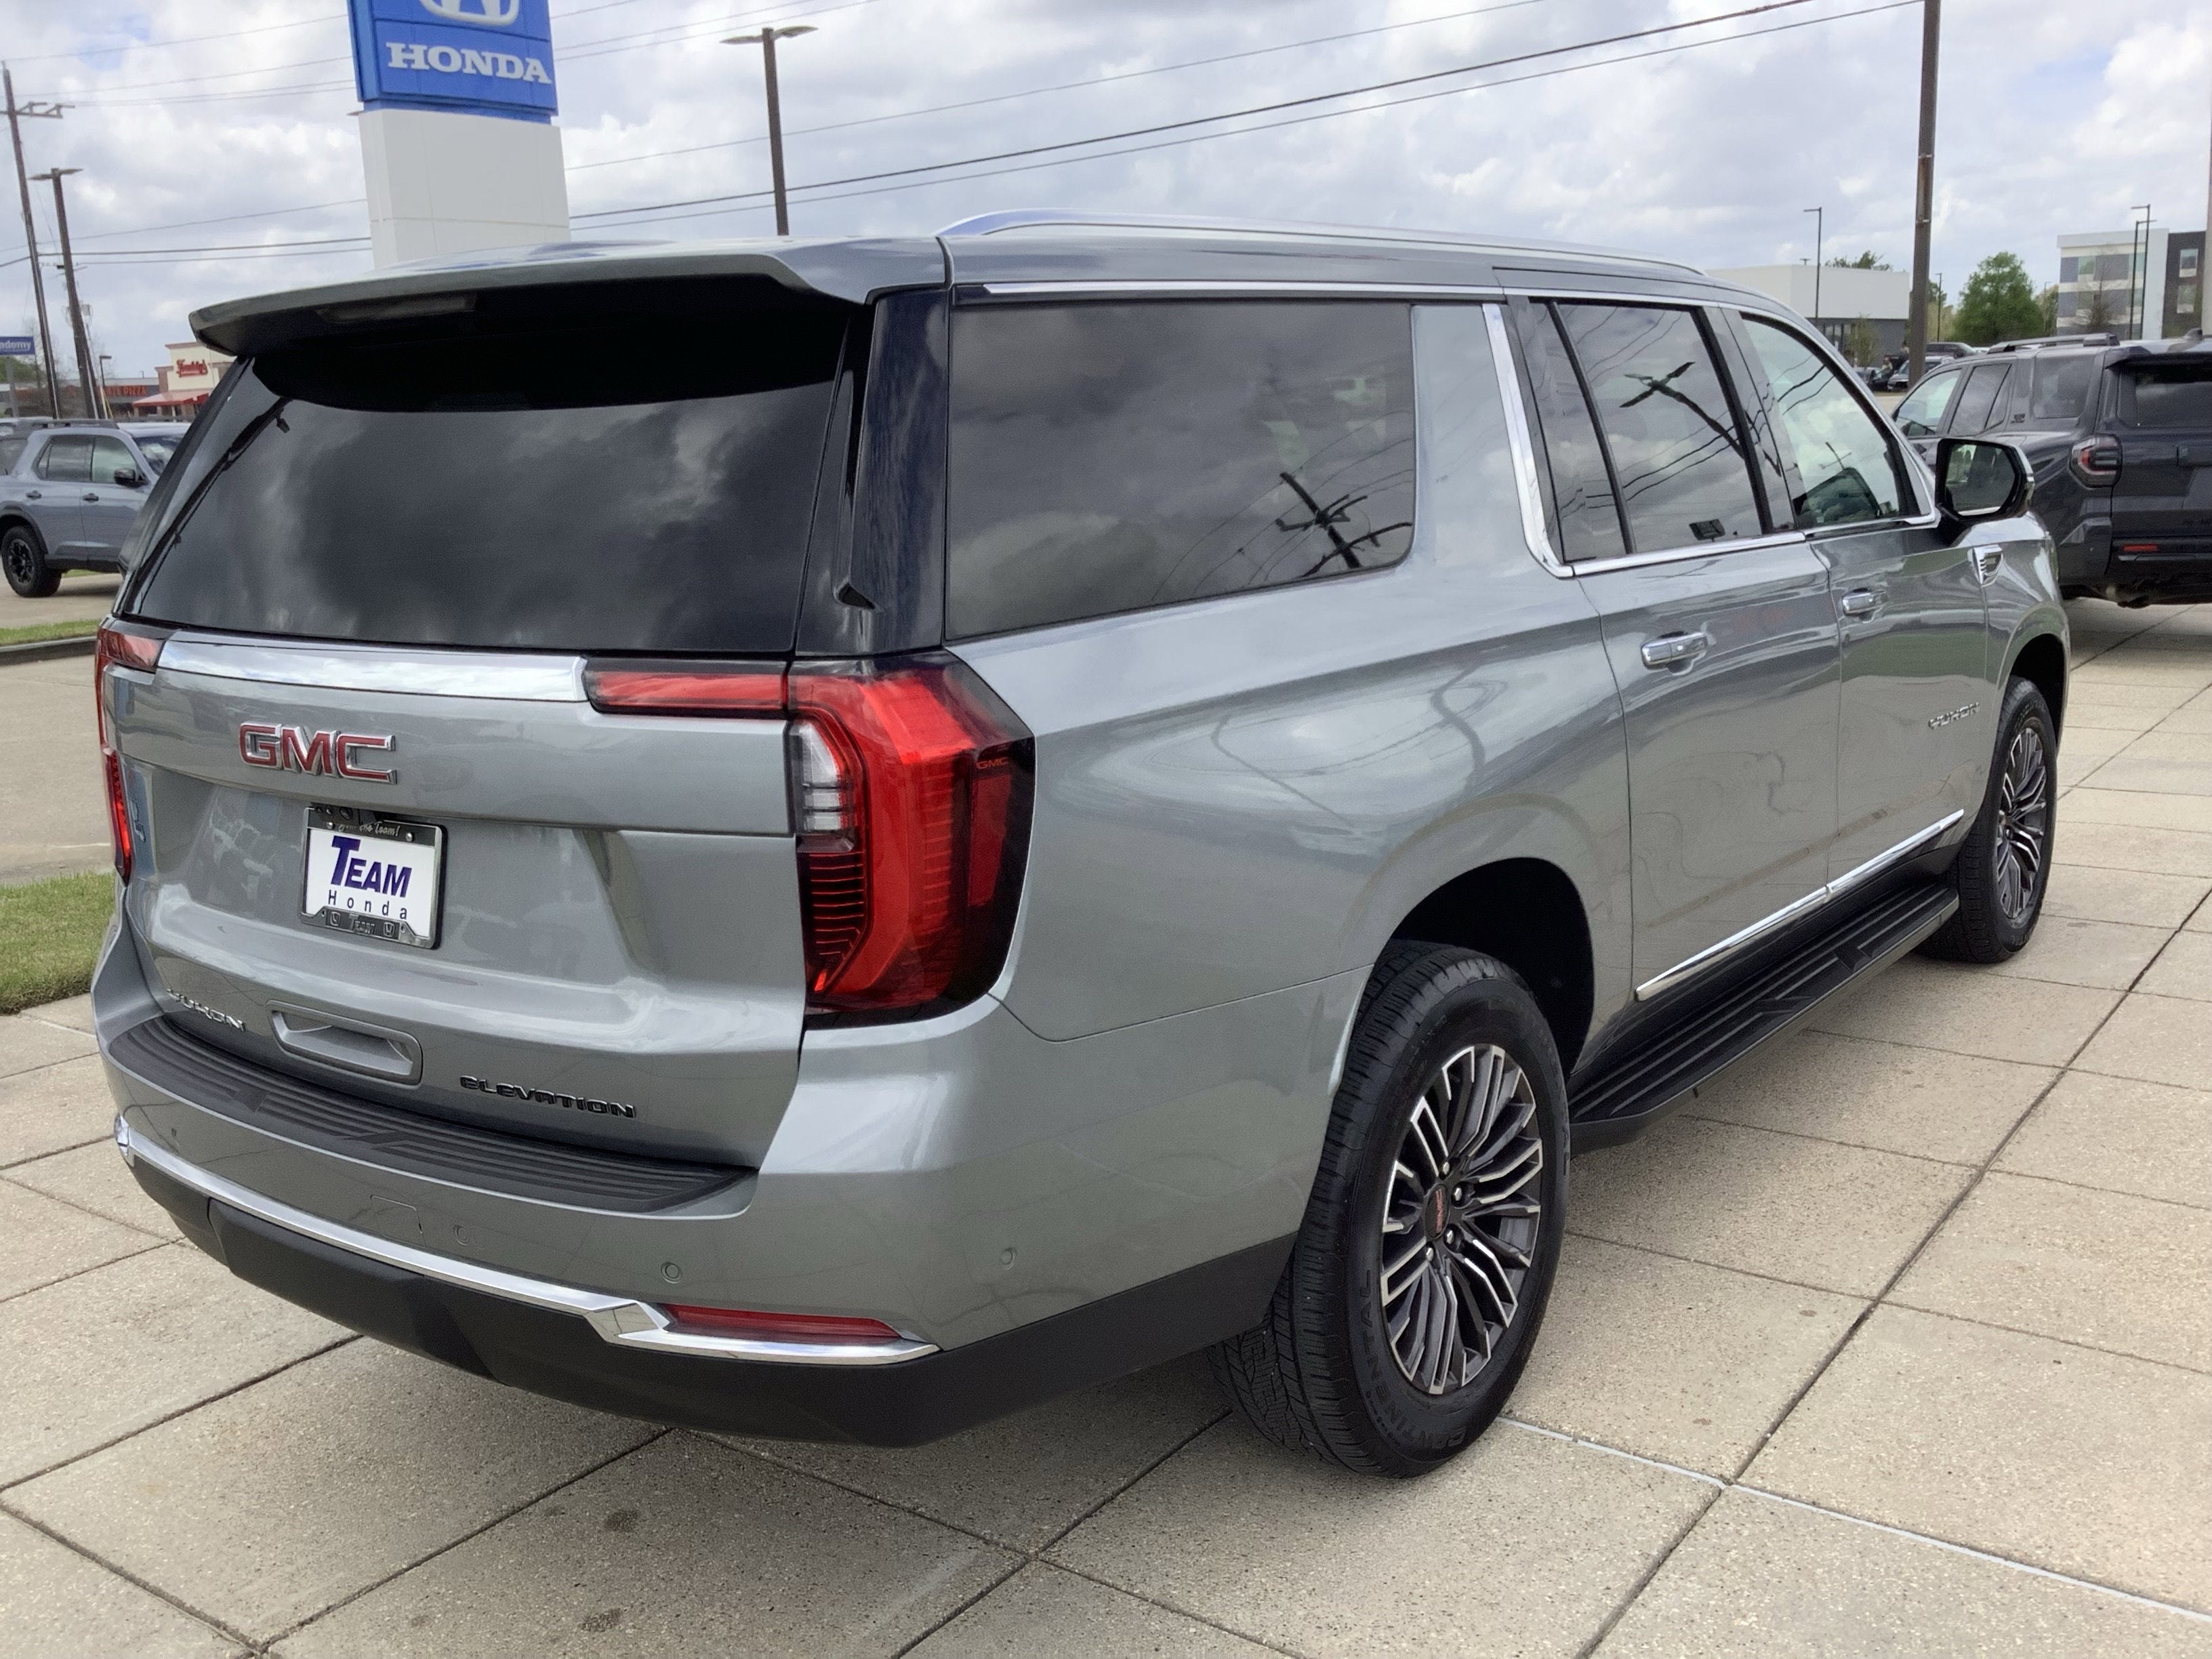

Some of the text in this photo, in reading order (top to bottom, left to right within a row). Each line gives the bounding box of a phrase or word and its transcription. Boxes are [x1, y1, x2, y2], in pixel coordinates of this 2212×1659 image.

[386, 42, 552, 84] HONDA
[1927, 702, 1980, 729] YUKON
[239, 722, 398, 785] GMC
[976, 756, 1010, 770] GMC
[331, 836, 412, 898] TEAM
[328, 890, 407, 920] Honda
[166, 988, 246, 1032] YUKON
[459, 1075, 636, 1118] ELEVATION
